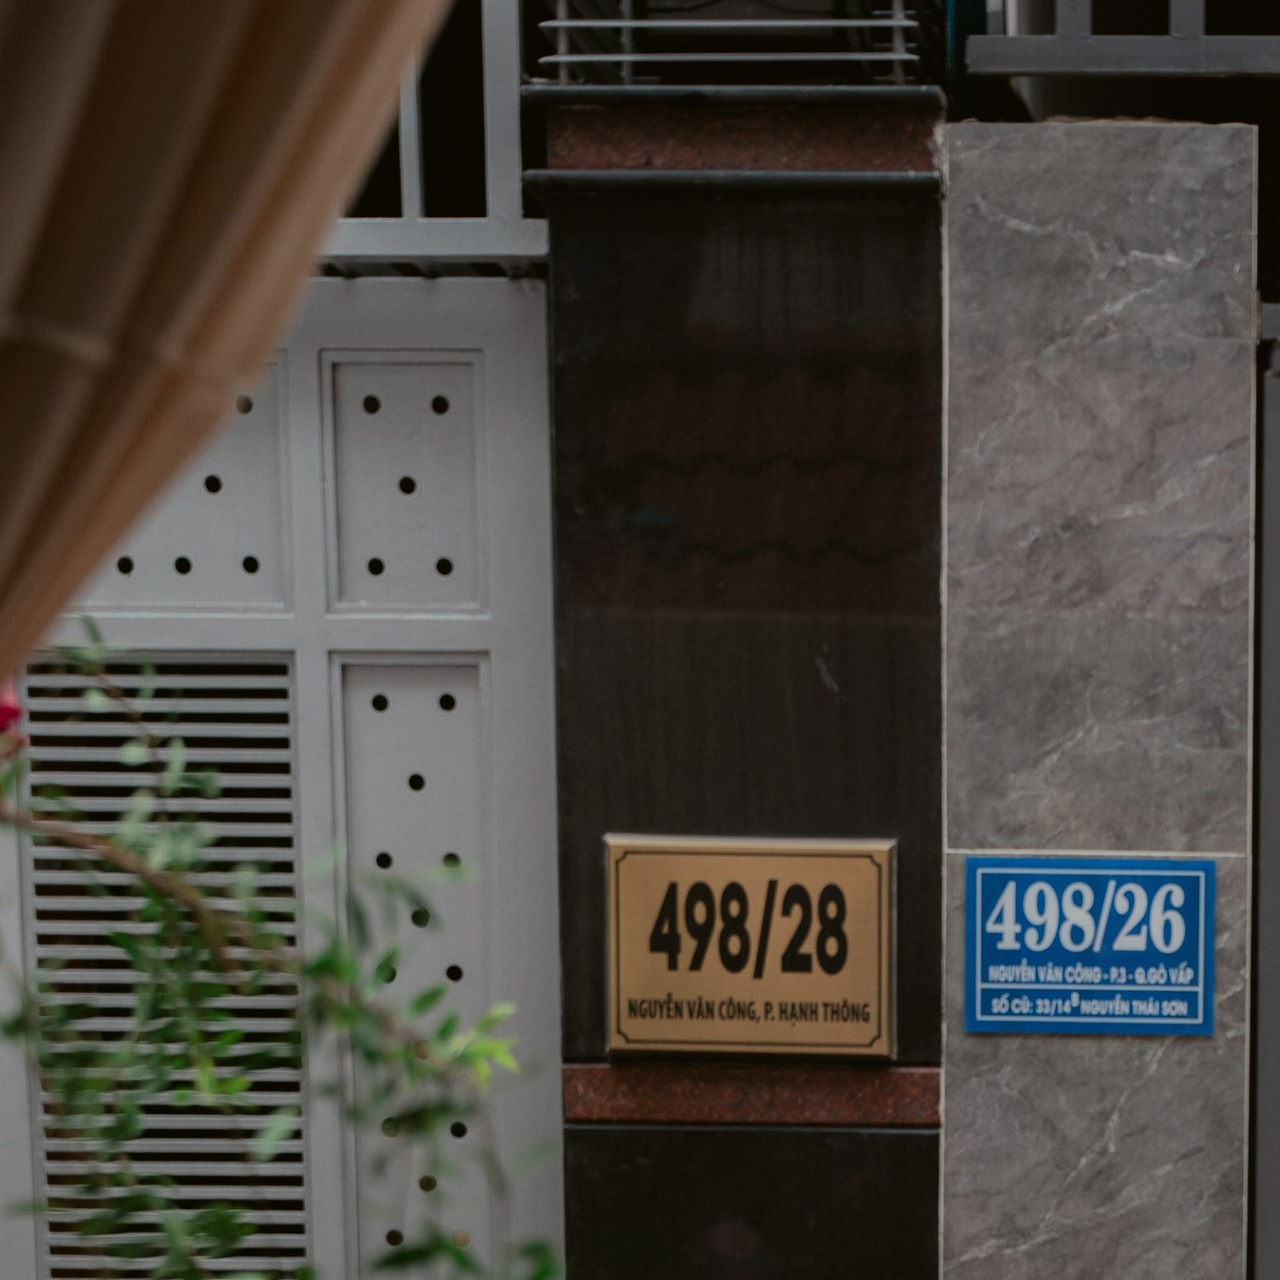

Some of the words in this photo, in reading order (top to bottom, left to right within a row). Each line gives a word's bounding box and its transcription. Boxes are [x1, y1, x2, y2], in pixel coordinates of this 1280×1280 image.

[649, 879, 848, 979] 498/28
[985, 879, 1186, 954] 498/26
[1038, 962, 1064, 984] VĂN
[627, 992, 683, 1020] NGUYỄN
[686, 996, 715, 1020] VĂN
[718, 996, 761, 1024] CÔNG,
[764, 1001, 775, 1021] P.
[779, 1001, 819, 1027] HẠNH
[823, 997, 870, 1023] THÔNG
